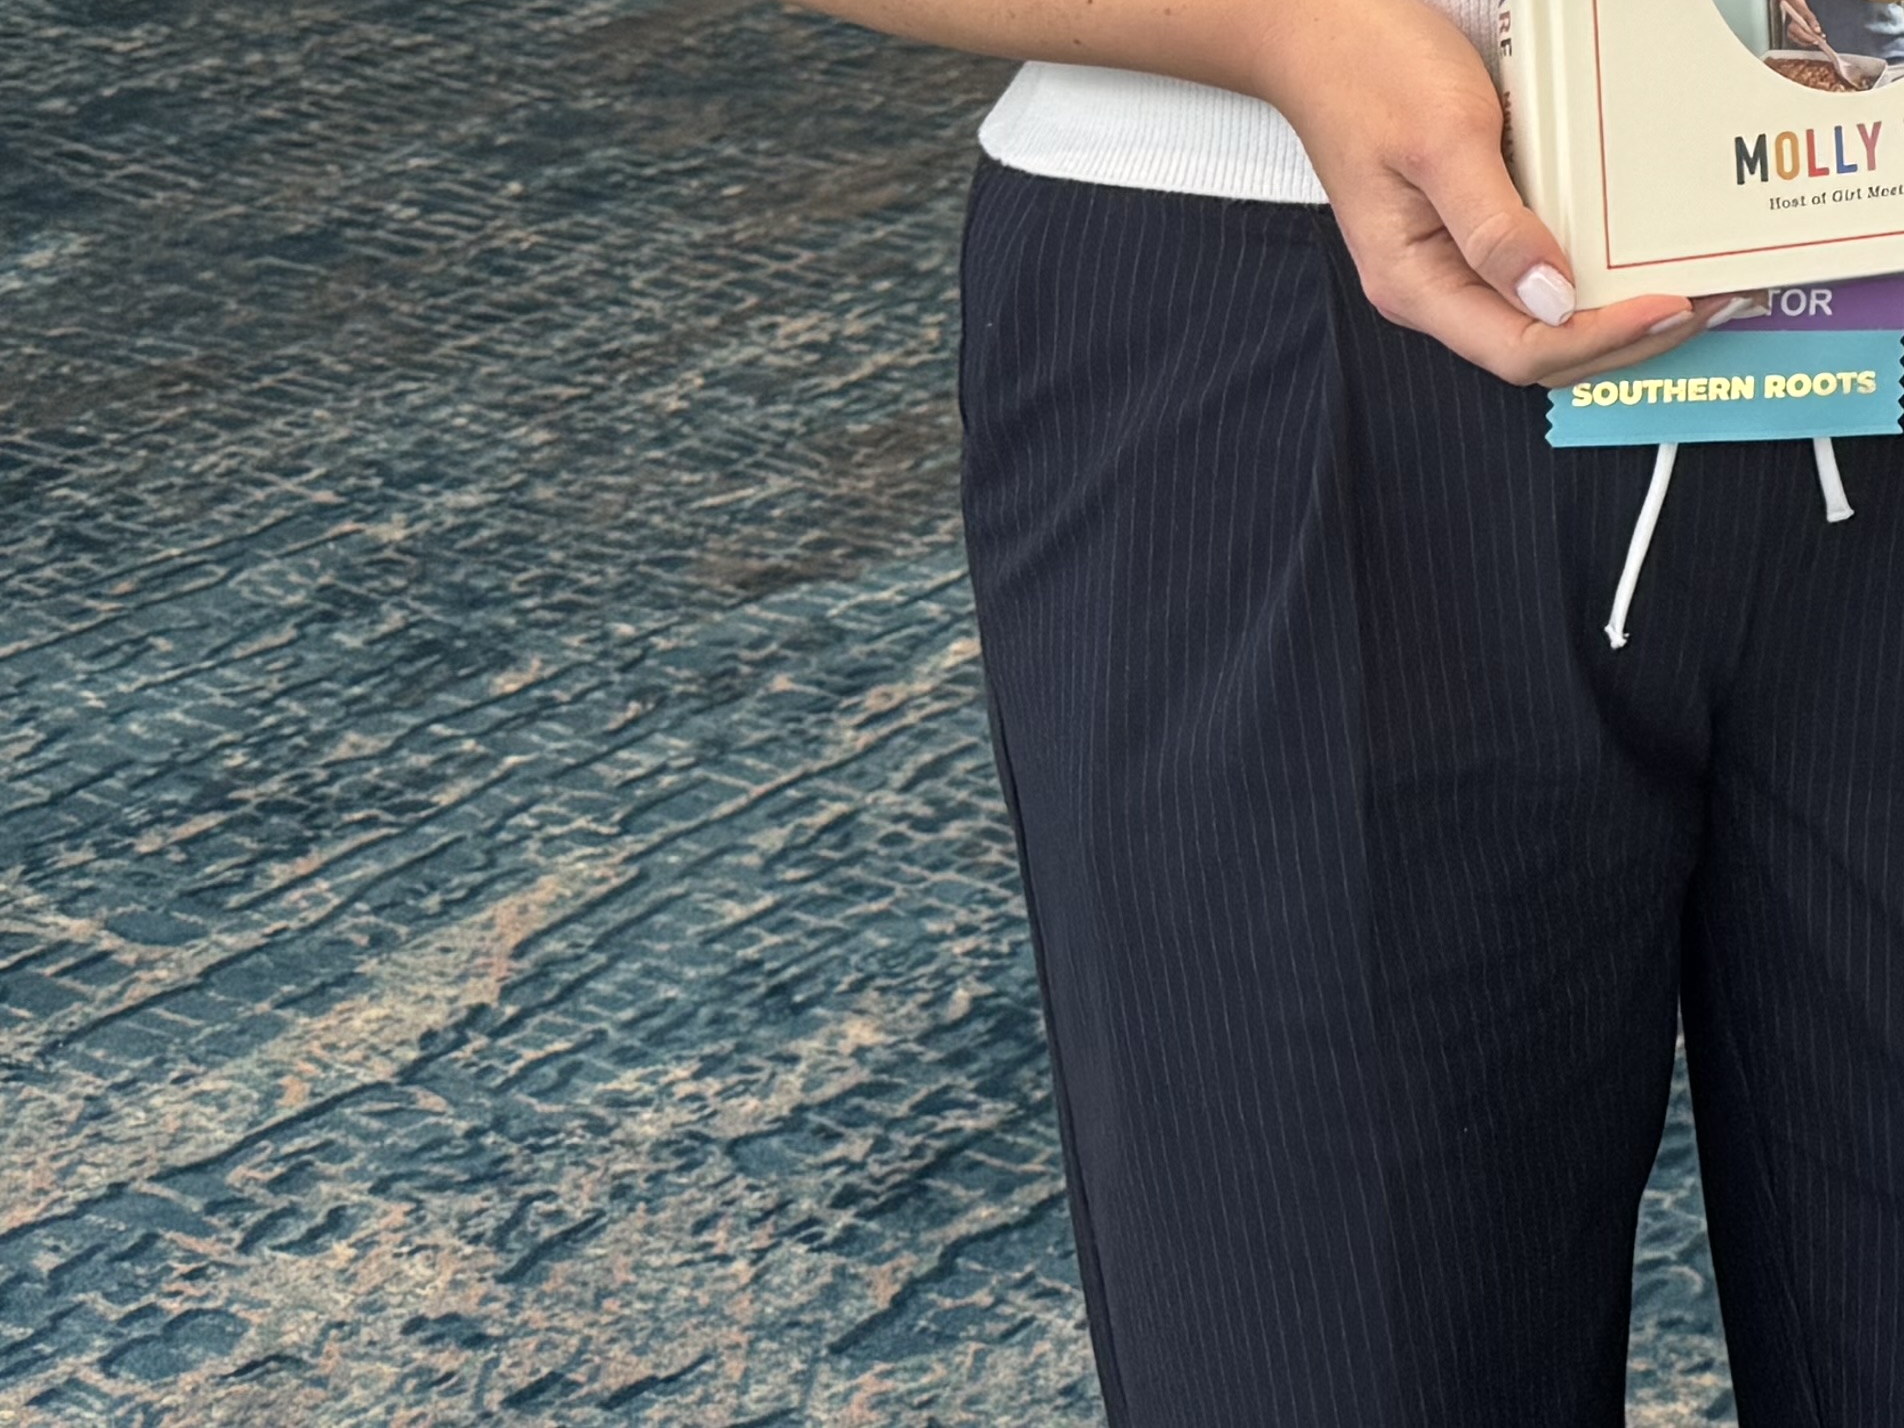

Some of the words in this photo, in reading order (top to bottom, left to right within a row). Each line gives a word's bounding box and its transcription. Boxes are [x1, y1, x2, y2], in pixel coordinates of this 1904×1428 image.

[1734, 121, 1883, 185] MOLLY
[1769, 197, 1807, 211] Host
[1811, 194, 1828, 206] of
[1832, 189, 1862, 203] Girl
[1571, 375, 1755, 409] SOUTHERN
[1764, 370, 1877, 399] ROOTS
